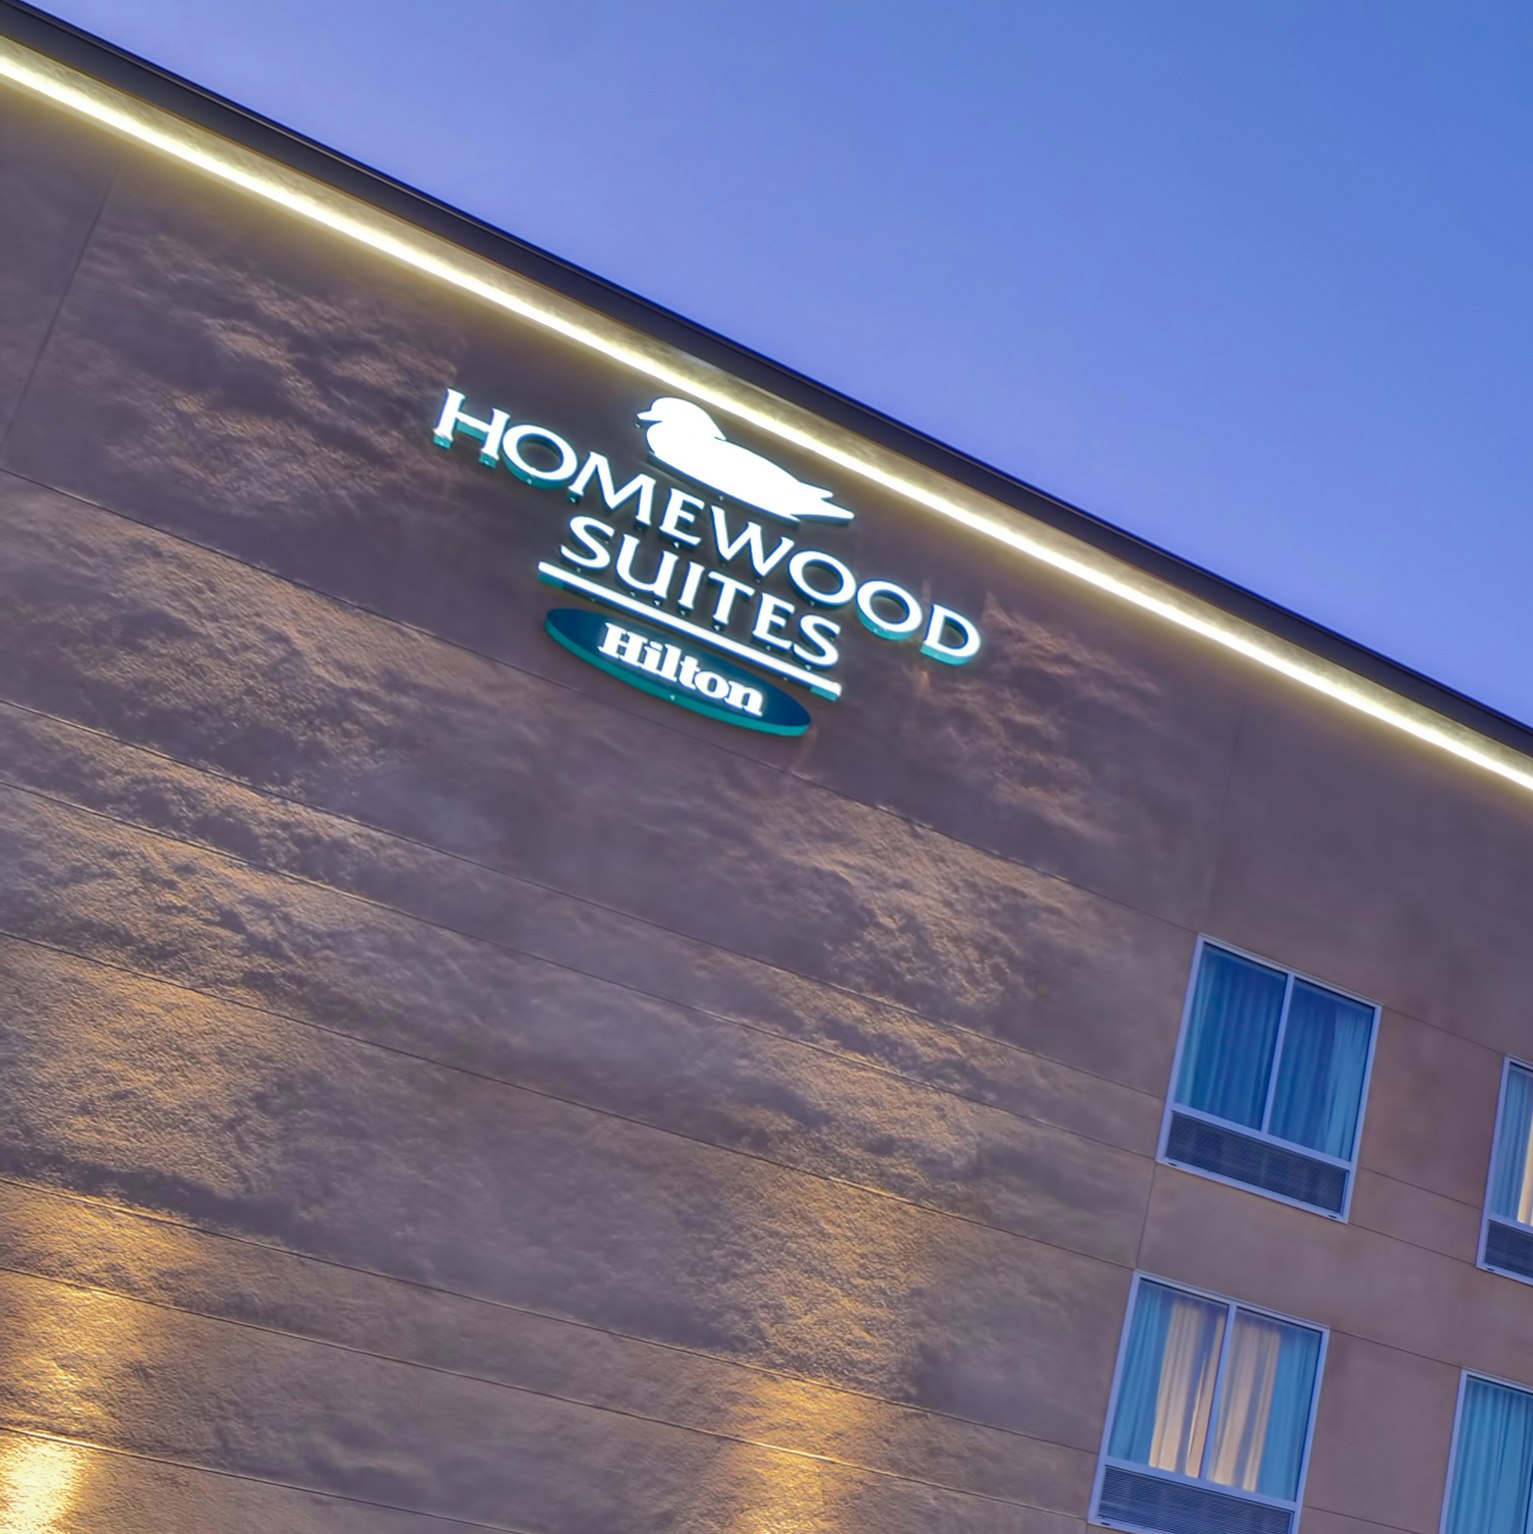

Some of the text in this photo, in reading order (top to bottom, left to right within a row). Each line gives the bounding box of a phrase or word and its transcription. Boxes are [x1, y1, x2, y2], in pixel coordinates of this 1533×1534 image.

[433, 388, 981, 664] HOMEWOOD
[561, 515, 841, 666] SUITES
[597, 622, 763, 716] Hilton
